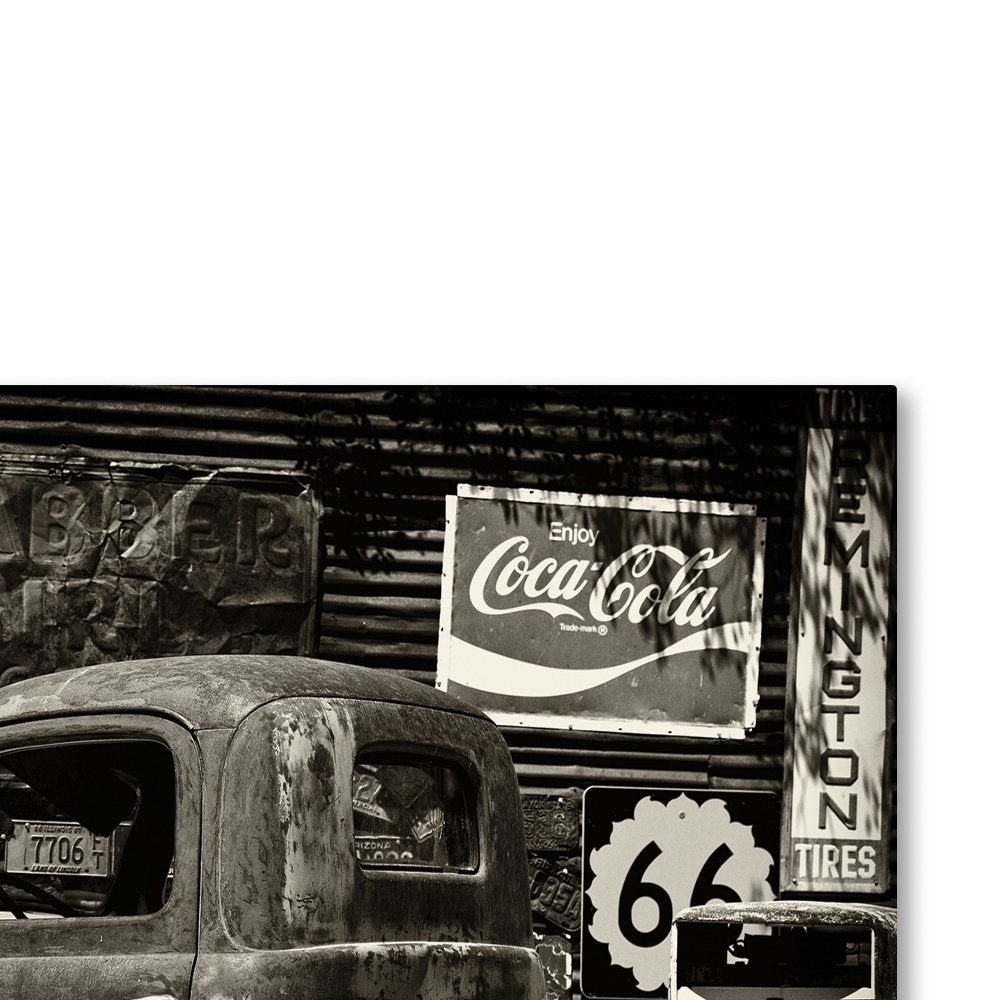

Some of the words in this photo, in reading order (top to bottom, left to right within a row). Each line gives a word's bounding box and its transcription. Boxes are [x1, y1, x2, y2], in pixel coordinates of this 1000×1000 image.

[815, 387, 884, 424] TIR
[548, 522, 599, 547] Enjoy
[469, 536, 732, 628] Coca-Cola
[818, 437, 871, 831] REMINGTON
[30, 835, 85, 865] 7706
[794, 844, 876, 880] TIRES
[618, 840, 743, 948] 66
